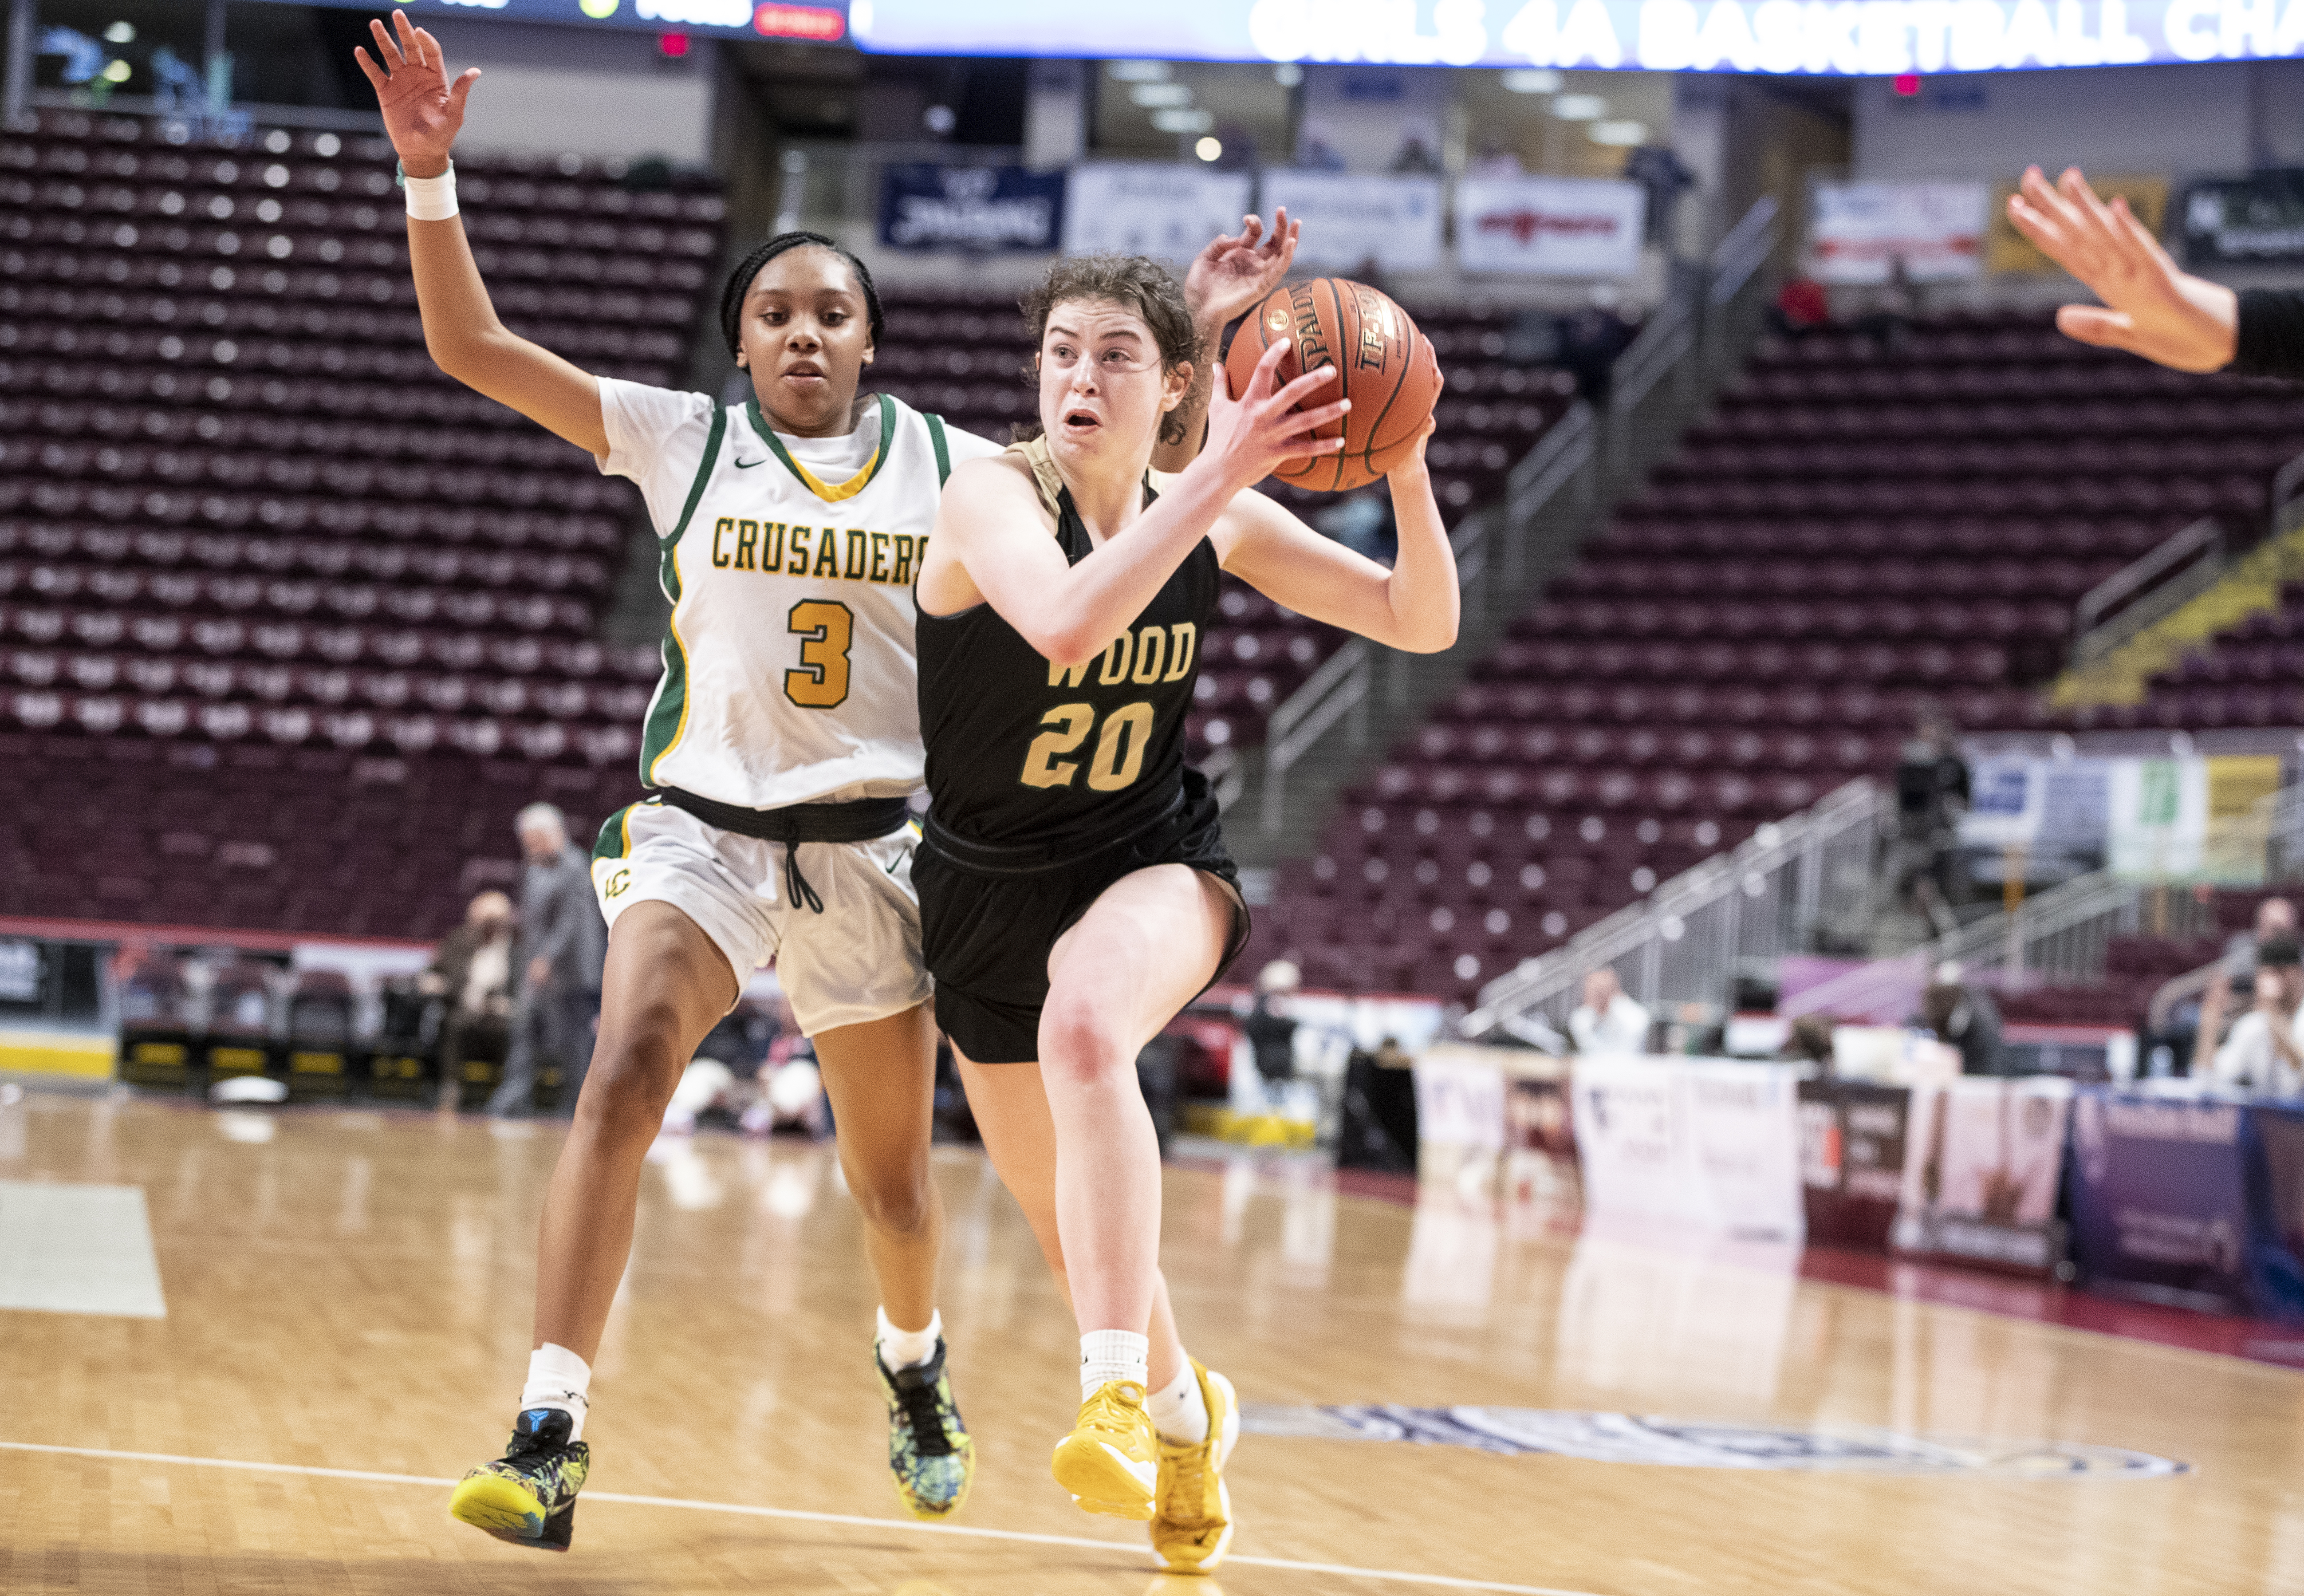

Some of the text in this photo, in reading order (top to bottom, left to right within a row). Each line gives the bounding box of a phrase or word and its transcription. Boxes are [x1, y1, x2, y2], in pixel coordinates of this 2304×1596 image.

[1248, 0, 1487, 63] GIRLS
[1502, 0, 1621, 67] 4A
[1638, 0, 2150, 72] BASKETBALL
[784, 598, 854, 709] 3
[1020, 702, 1154, 791] 20
